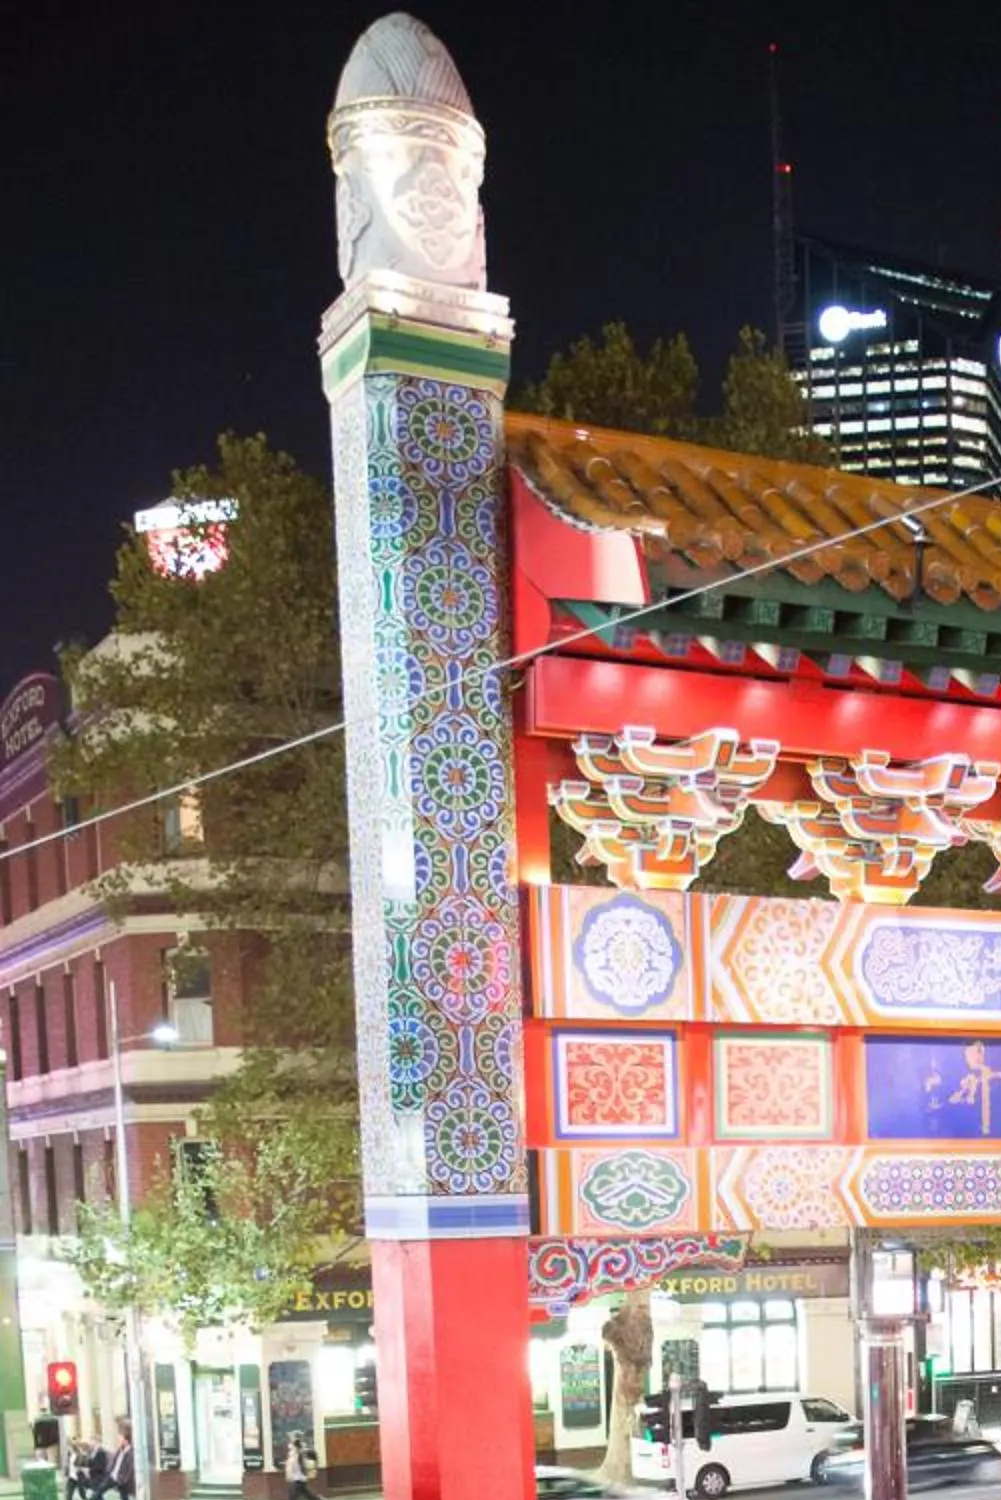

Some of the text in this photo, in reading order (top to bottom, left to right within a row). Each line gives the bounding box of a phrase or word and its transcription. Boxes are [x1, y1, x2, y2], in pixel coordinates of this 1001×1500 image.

[5, 717, 42, 759] HOTEL
[662, 1273, 817, 1295] XFORD HOTEL
